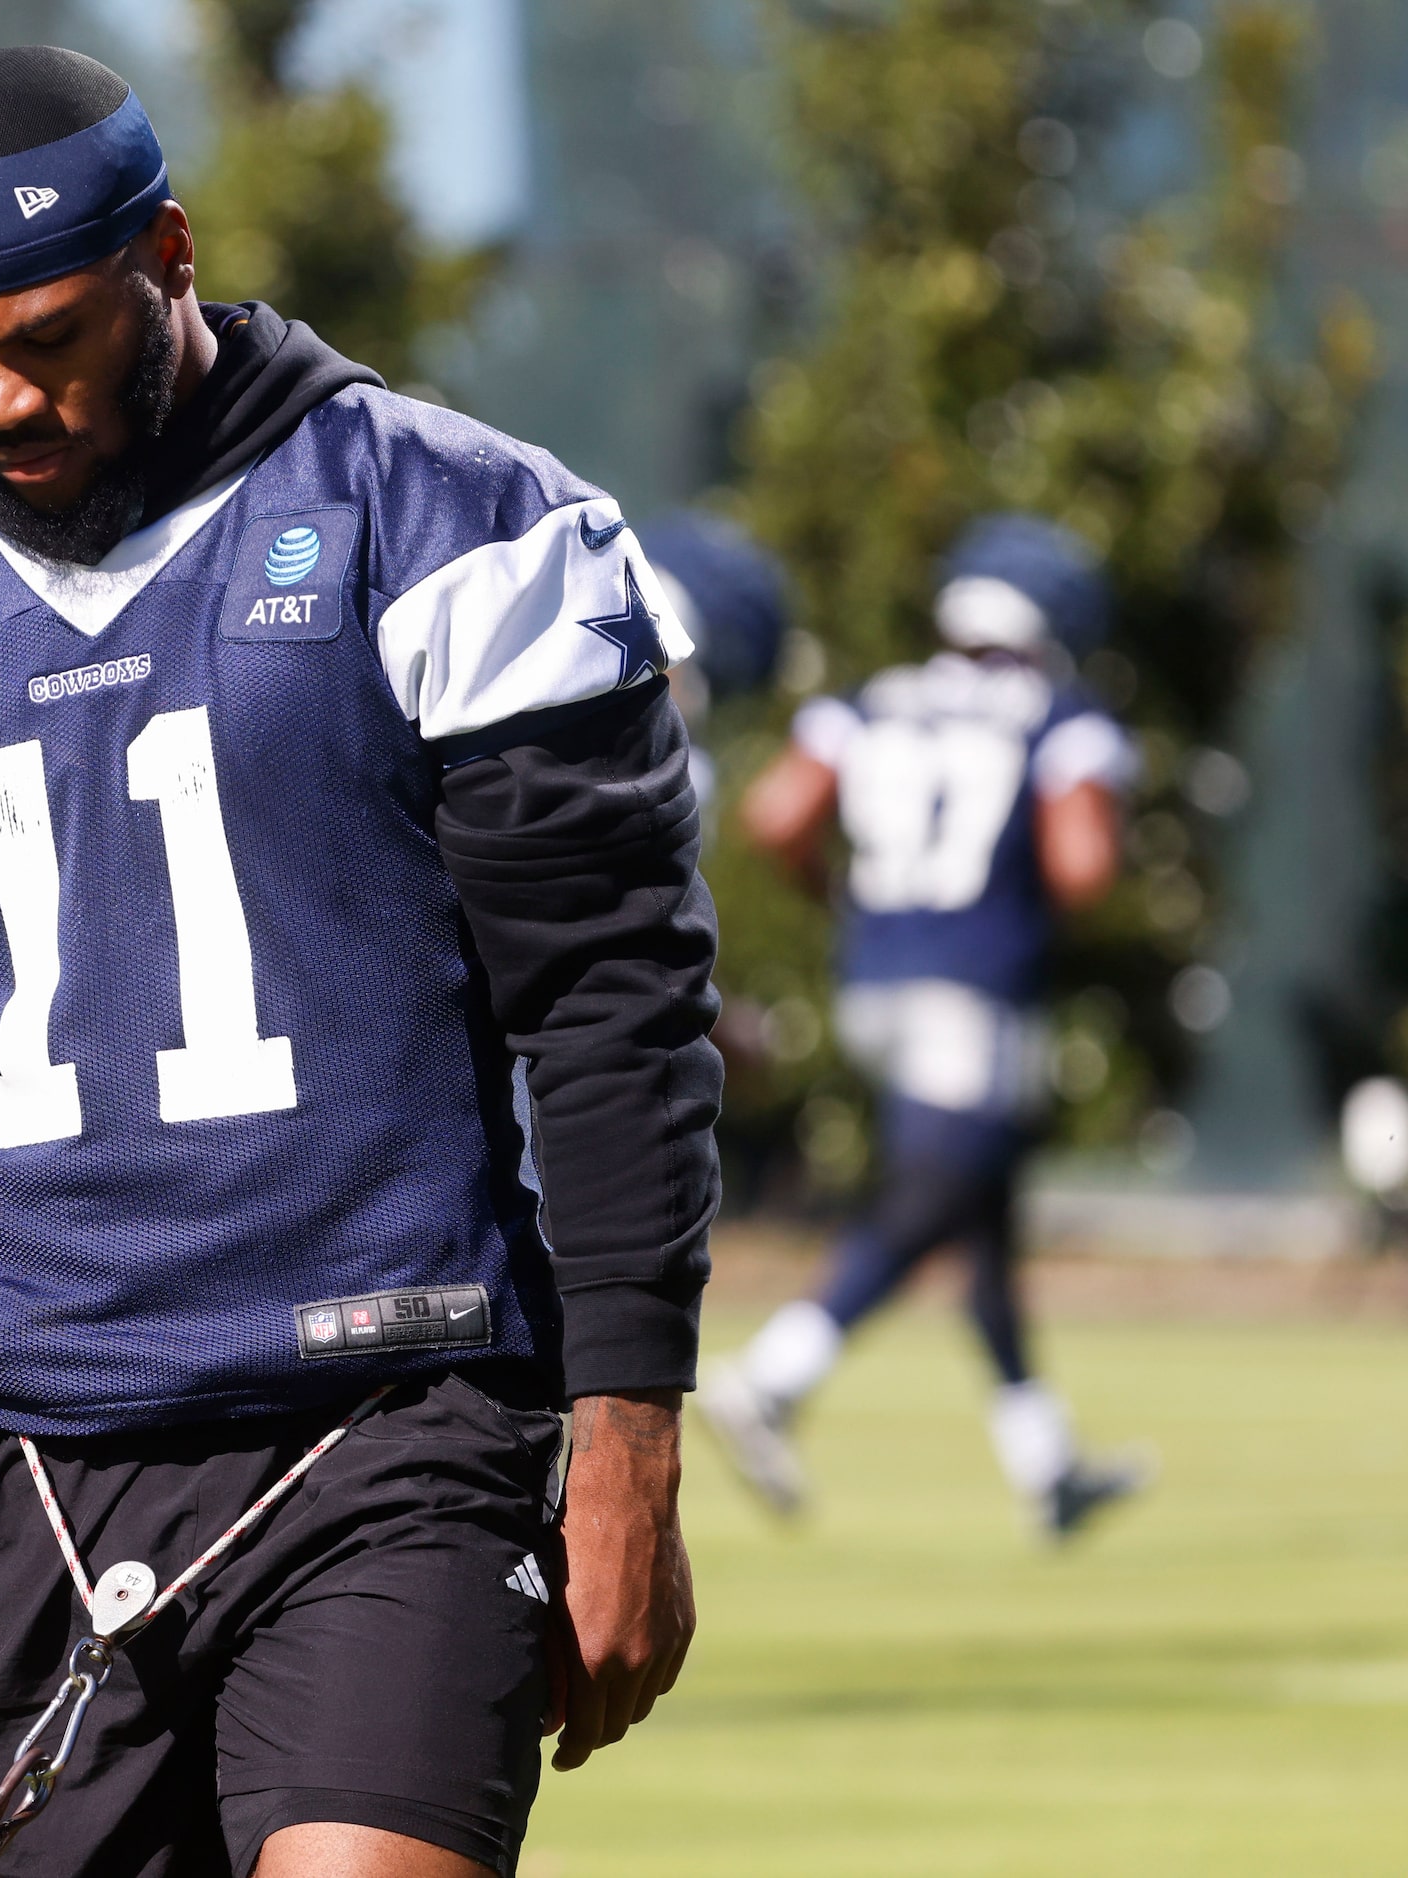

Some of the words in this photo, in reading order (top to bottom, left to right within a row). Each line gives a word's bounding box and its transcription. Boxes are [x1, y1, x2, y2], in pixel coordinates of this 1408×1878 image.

[245, 594, 318, 626] AT&T
[28, 653, 151, 702] COWBOYS
[393, 1296, 431, 1319] 50
[314, 1323, 334, 1338] NFL
